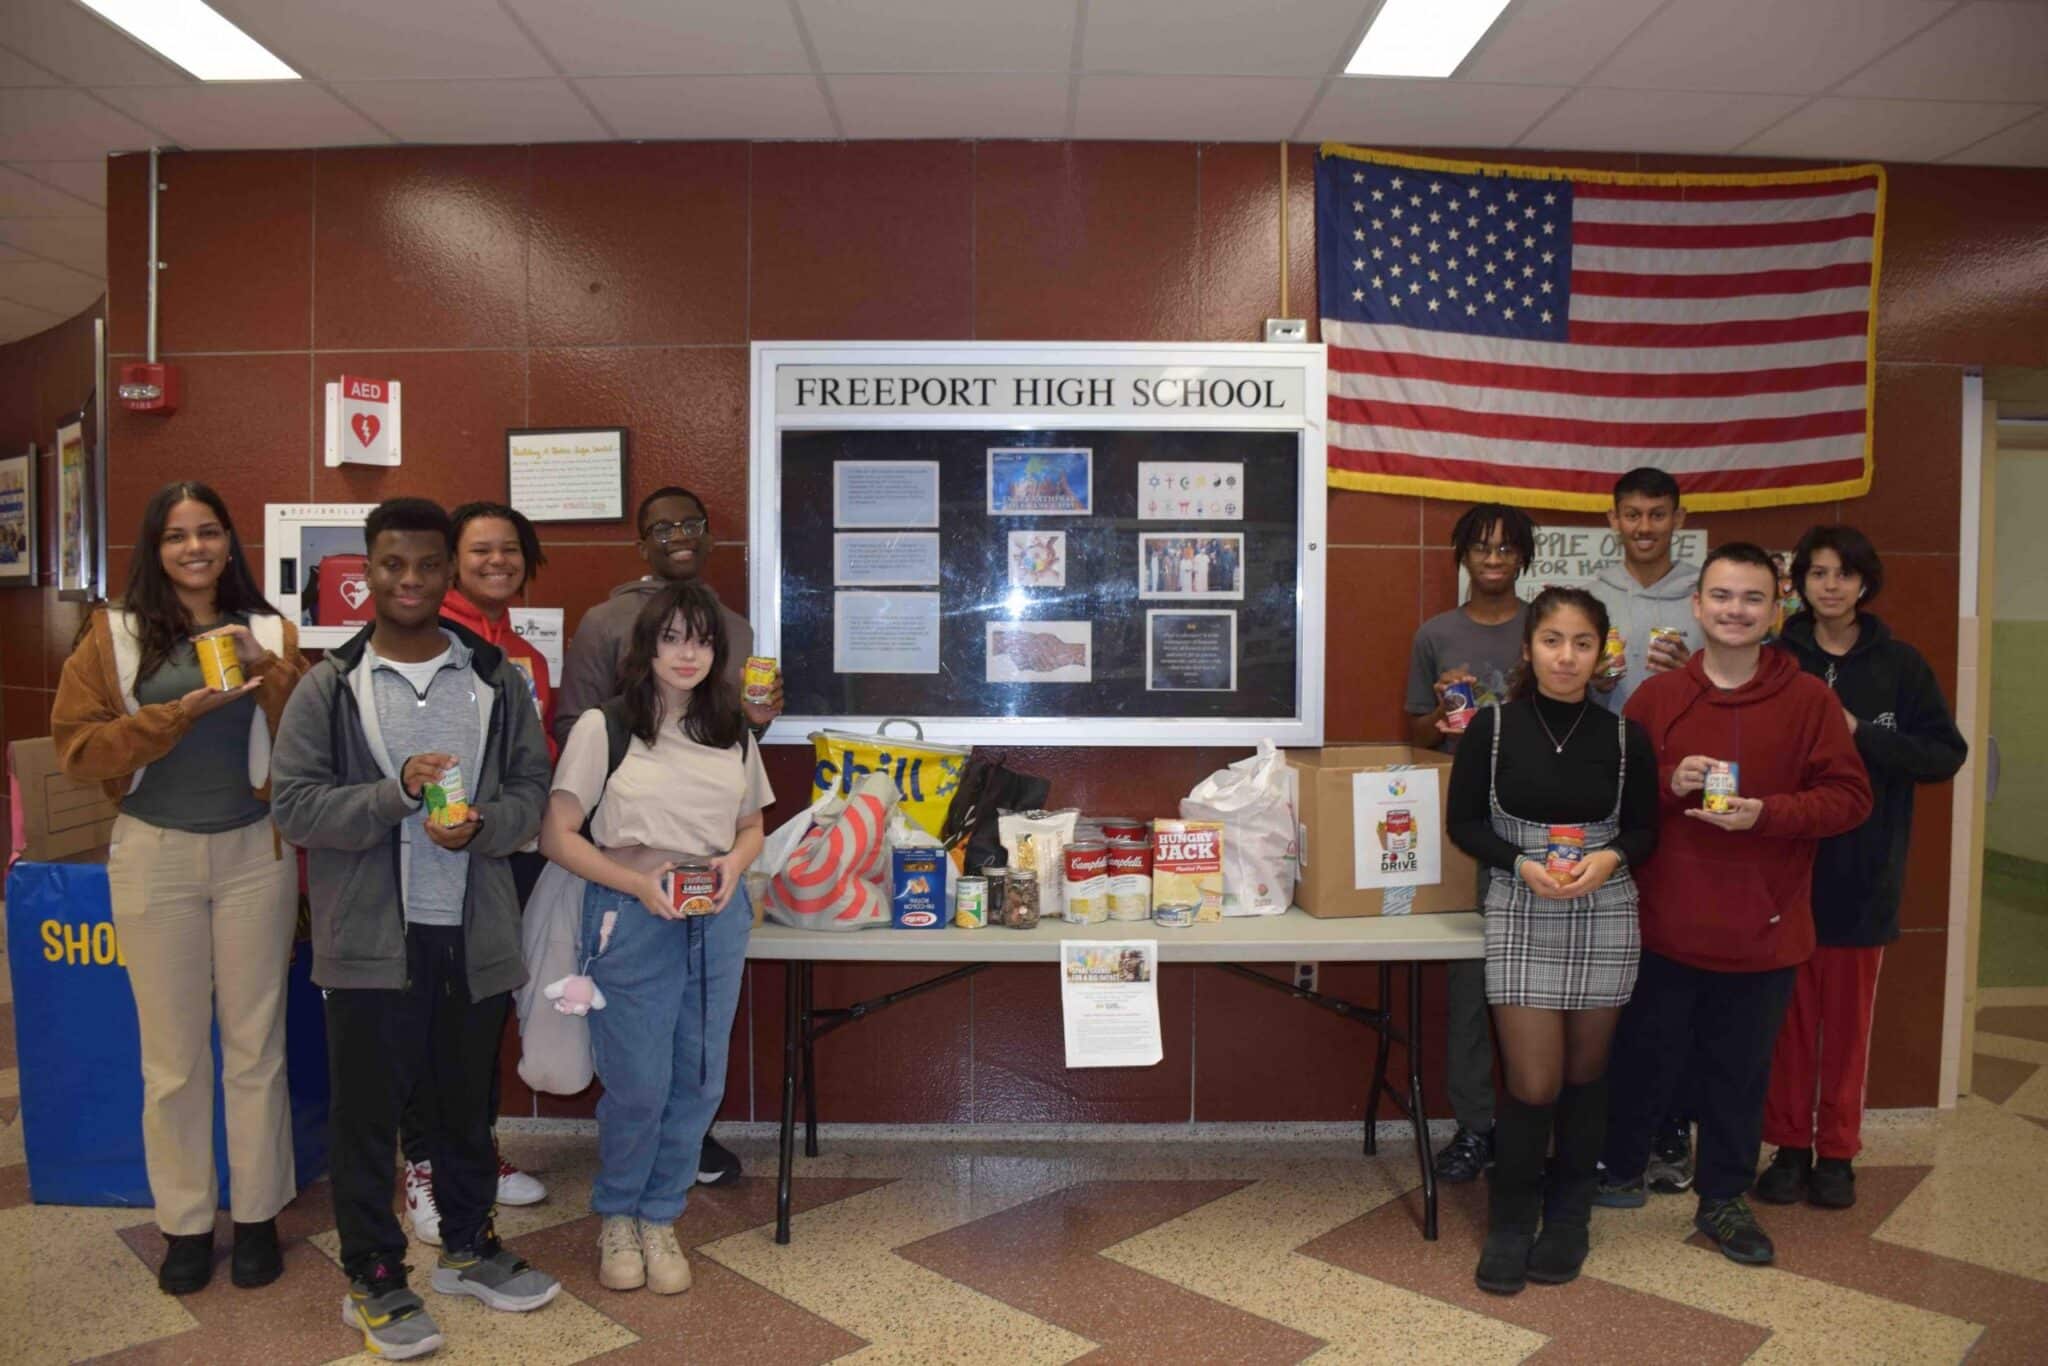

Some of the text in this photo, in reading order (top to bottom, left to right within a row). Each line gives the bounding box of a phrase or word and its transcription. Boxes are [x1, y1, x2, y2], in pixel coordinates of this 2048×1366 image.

[351, 380, 381, 400] AED
[795, 377, 1286, 408] FREEPORT HIGH SCHOOL
[1534, 532, 1589, 557] PPLE
[1528, 560, 1569, 578] FOR
[1156, 831, 1216, 861] HUNGRY JACK
[1108, 855, 1143, 869] ampbell's
[1381, 859, 1417, 871] DRIVE
